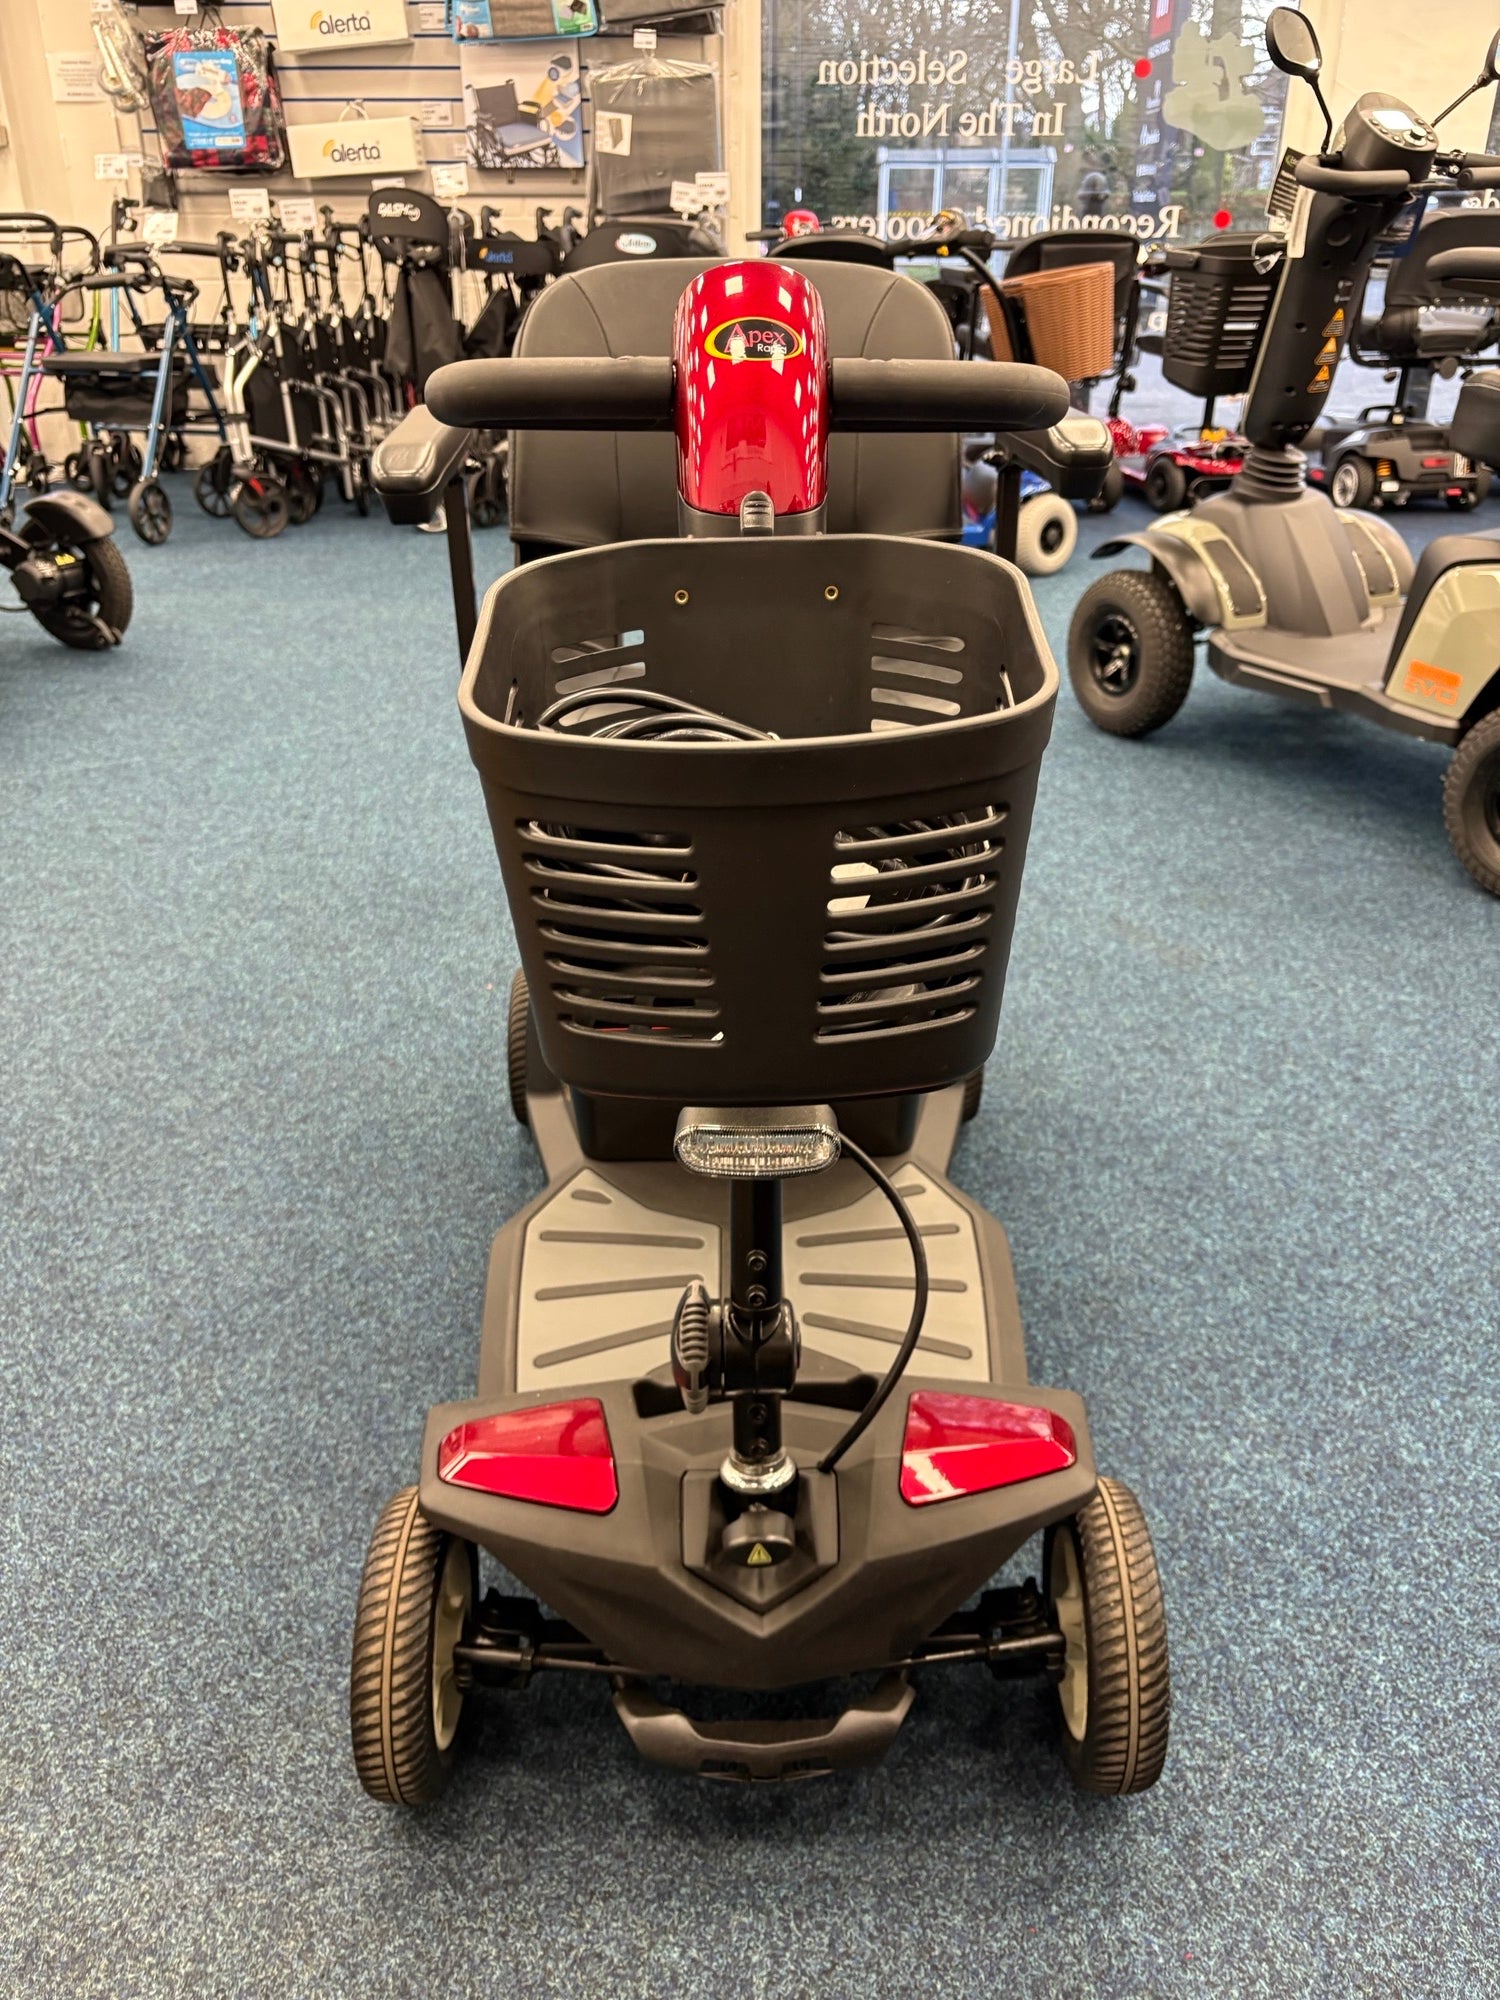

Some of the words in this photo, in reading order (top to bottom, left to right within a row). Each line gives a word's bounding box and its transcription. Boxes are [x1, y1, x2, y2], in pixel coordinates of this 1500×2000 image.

[319, 13, 371, 35] alerta
[331, 142, 381, 163] alerta
[724, 323, 786, 353] Apex
[1404, 676, 1458, 705] EVO
